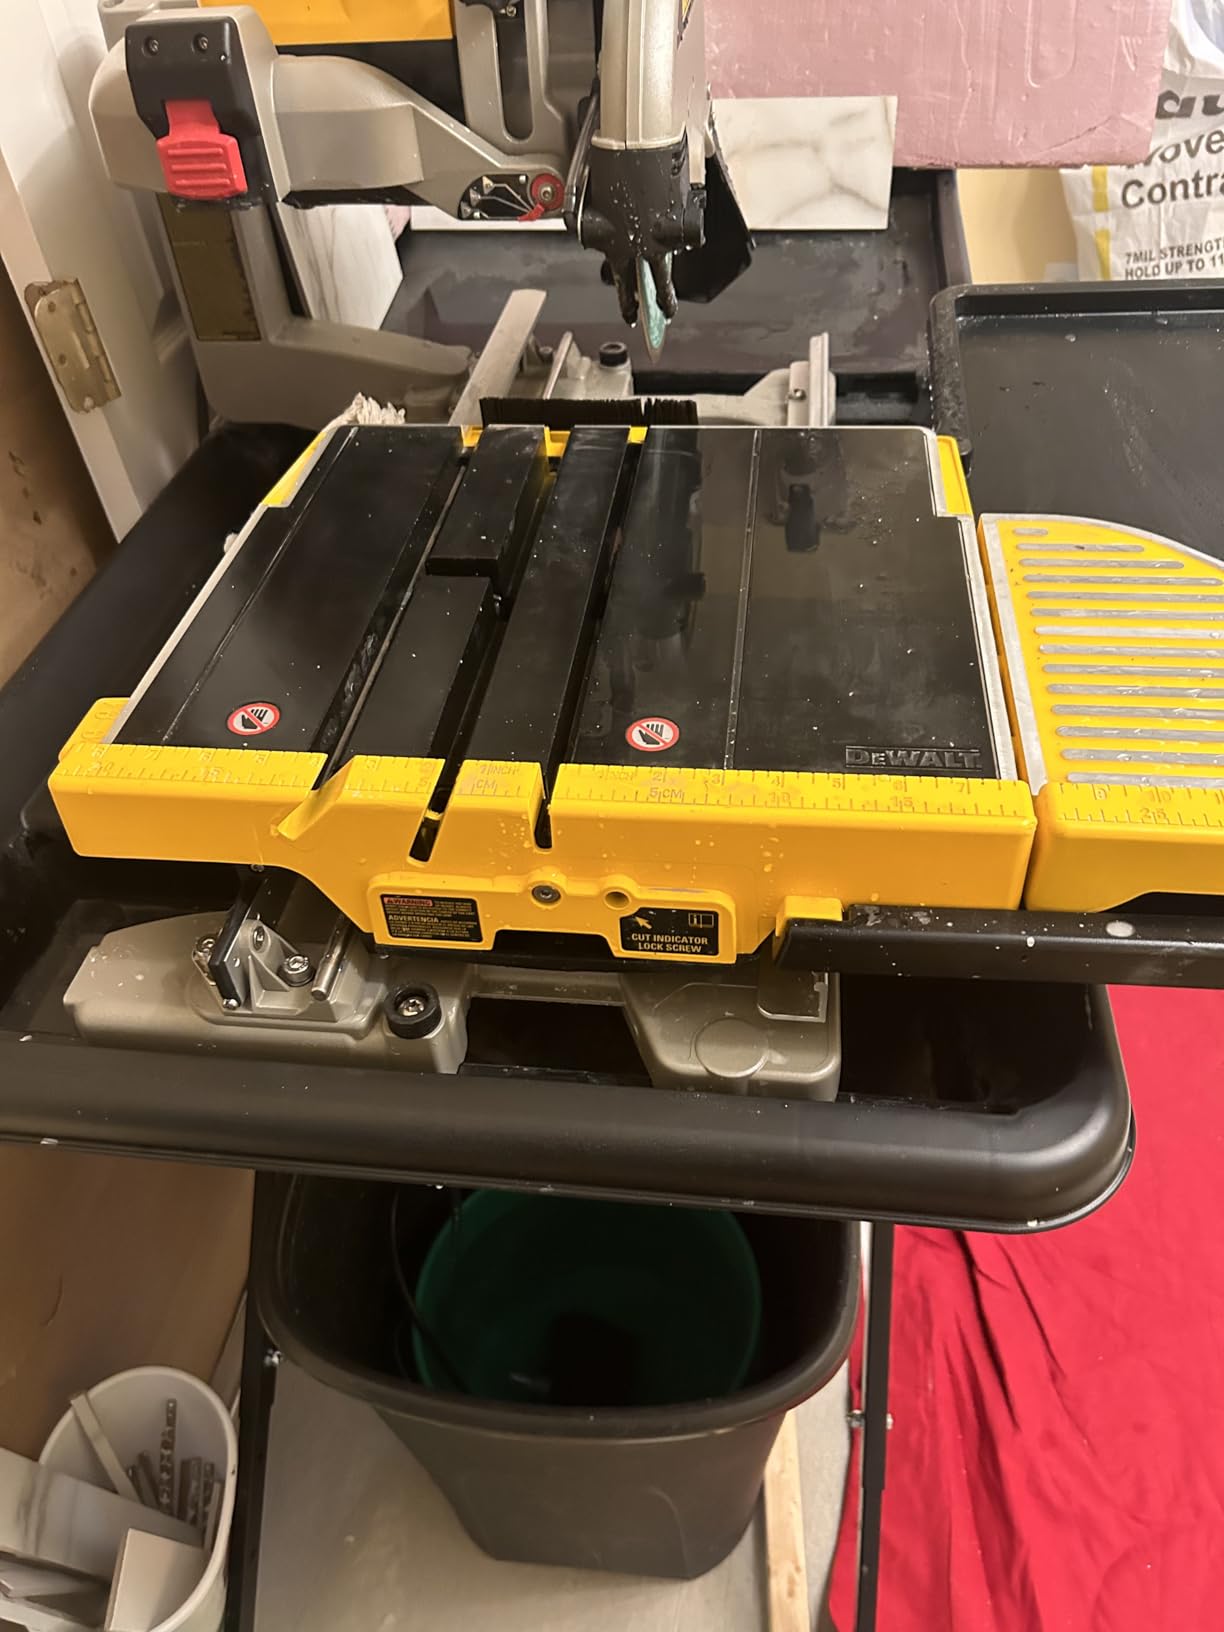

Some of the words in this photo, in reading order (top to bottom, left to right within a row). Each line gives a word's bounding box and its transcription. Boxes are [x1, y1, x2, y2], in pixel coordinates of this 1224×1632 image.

[1125, 249, 1156, 264] 7MIL
[1159, 236, 1224, 260] STRENGT
[1125, 263, 1161, 280] HOLD
[1165, 261, 1184, 275] UP
[1186, 257, 1205, 273] TO
[388, 915, 440, 923] ADVERTENCIA
[631, 933, 652, 942] CUT
[653, 934, 708, 945] INDICATOR
[638, 942, 664, 951] LOCK
[665, 943, 702, 953] SCREW
